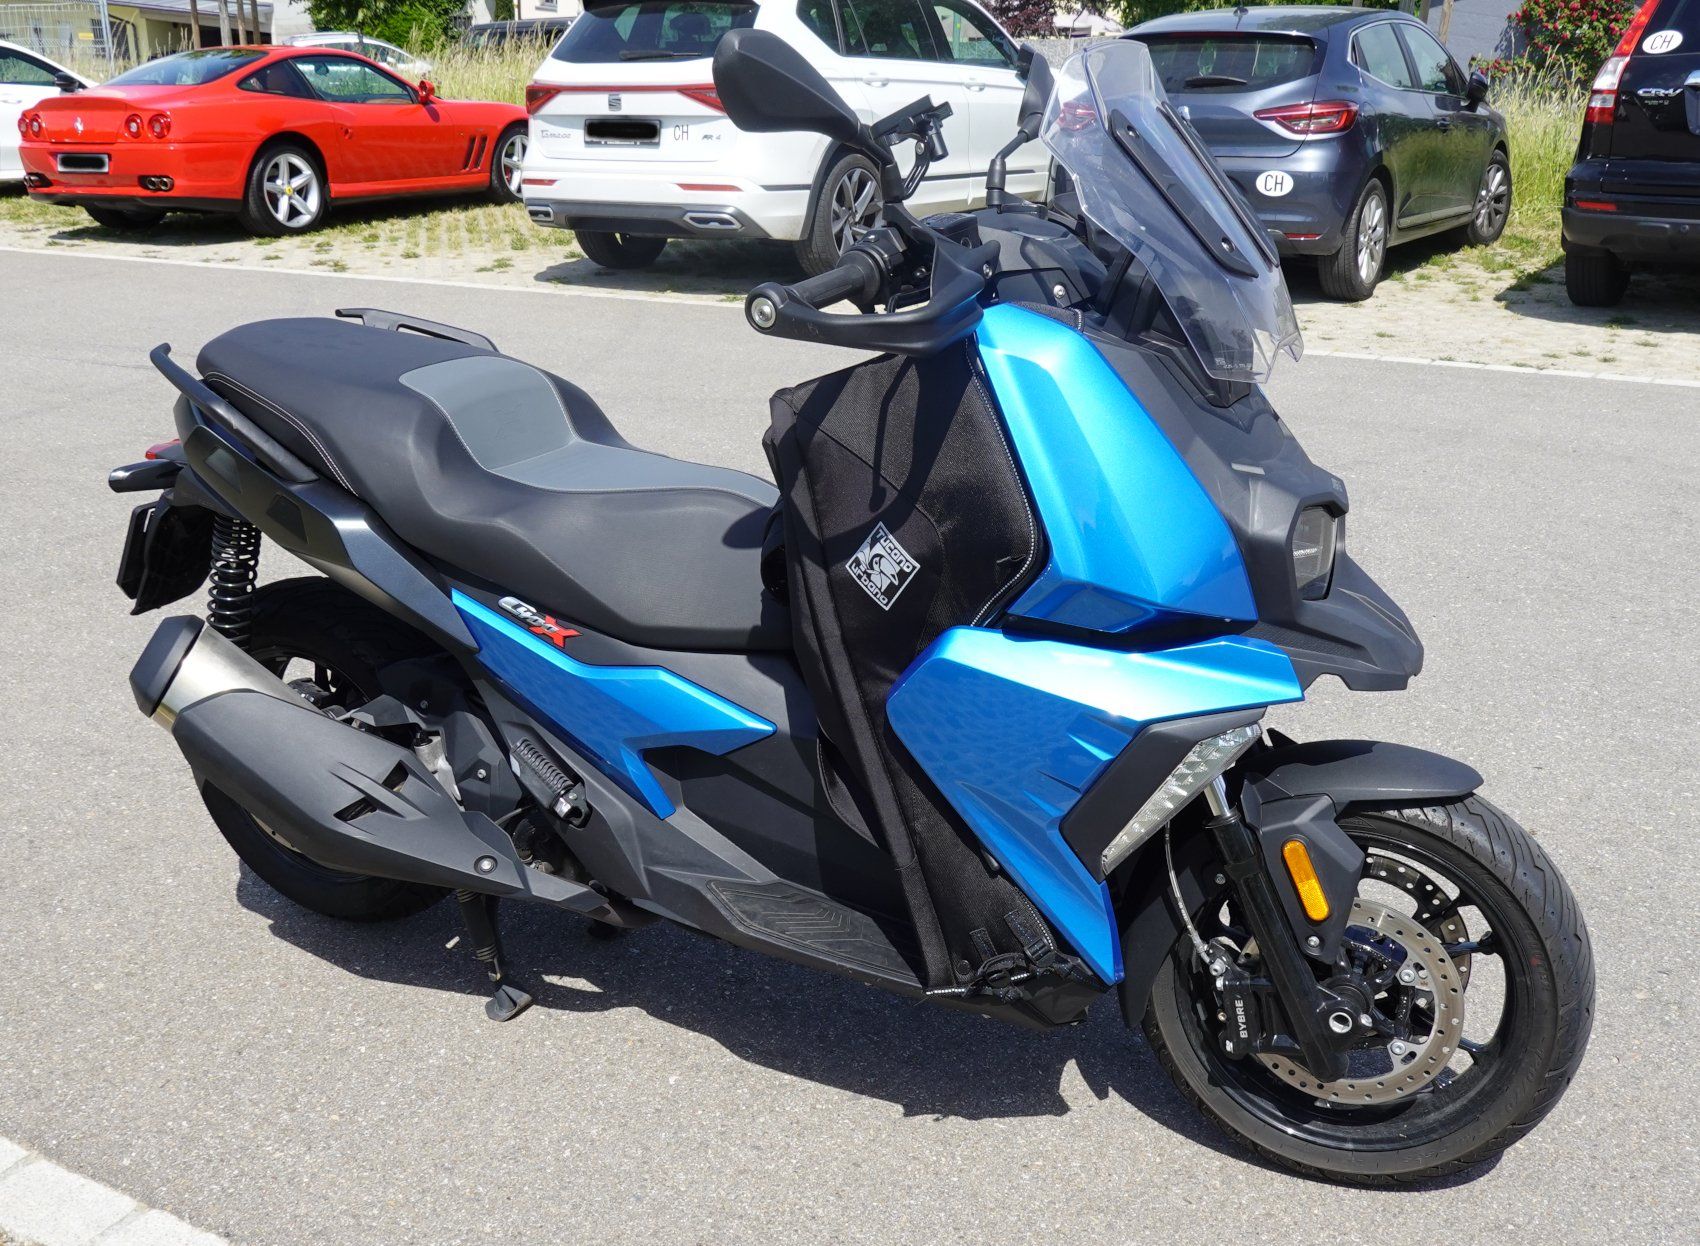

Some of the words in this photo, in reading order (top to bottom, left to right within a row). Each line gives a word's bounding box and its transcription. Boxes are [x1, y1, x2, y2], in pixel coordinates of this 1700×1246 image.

[1650, 34, 1675, 50] CH
[673, 124, 689, 141] CH
[1264, 174, 1284, 192] CH
[1234, 999, 1249, 1039] BYBRE
